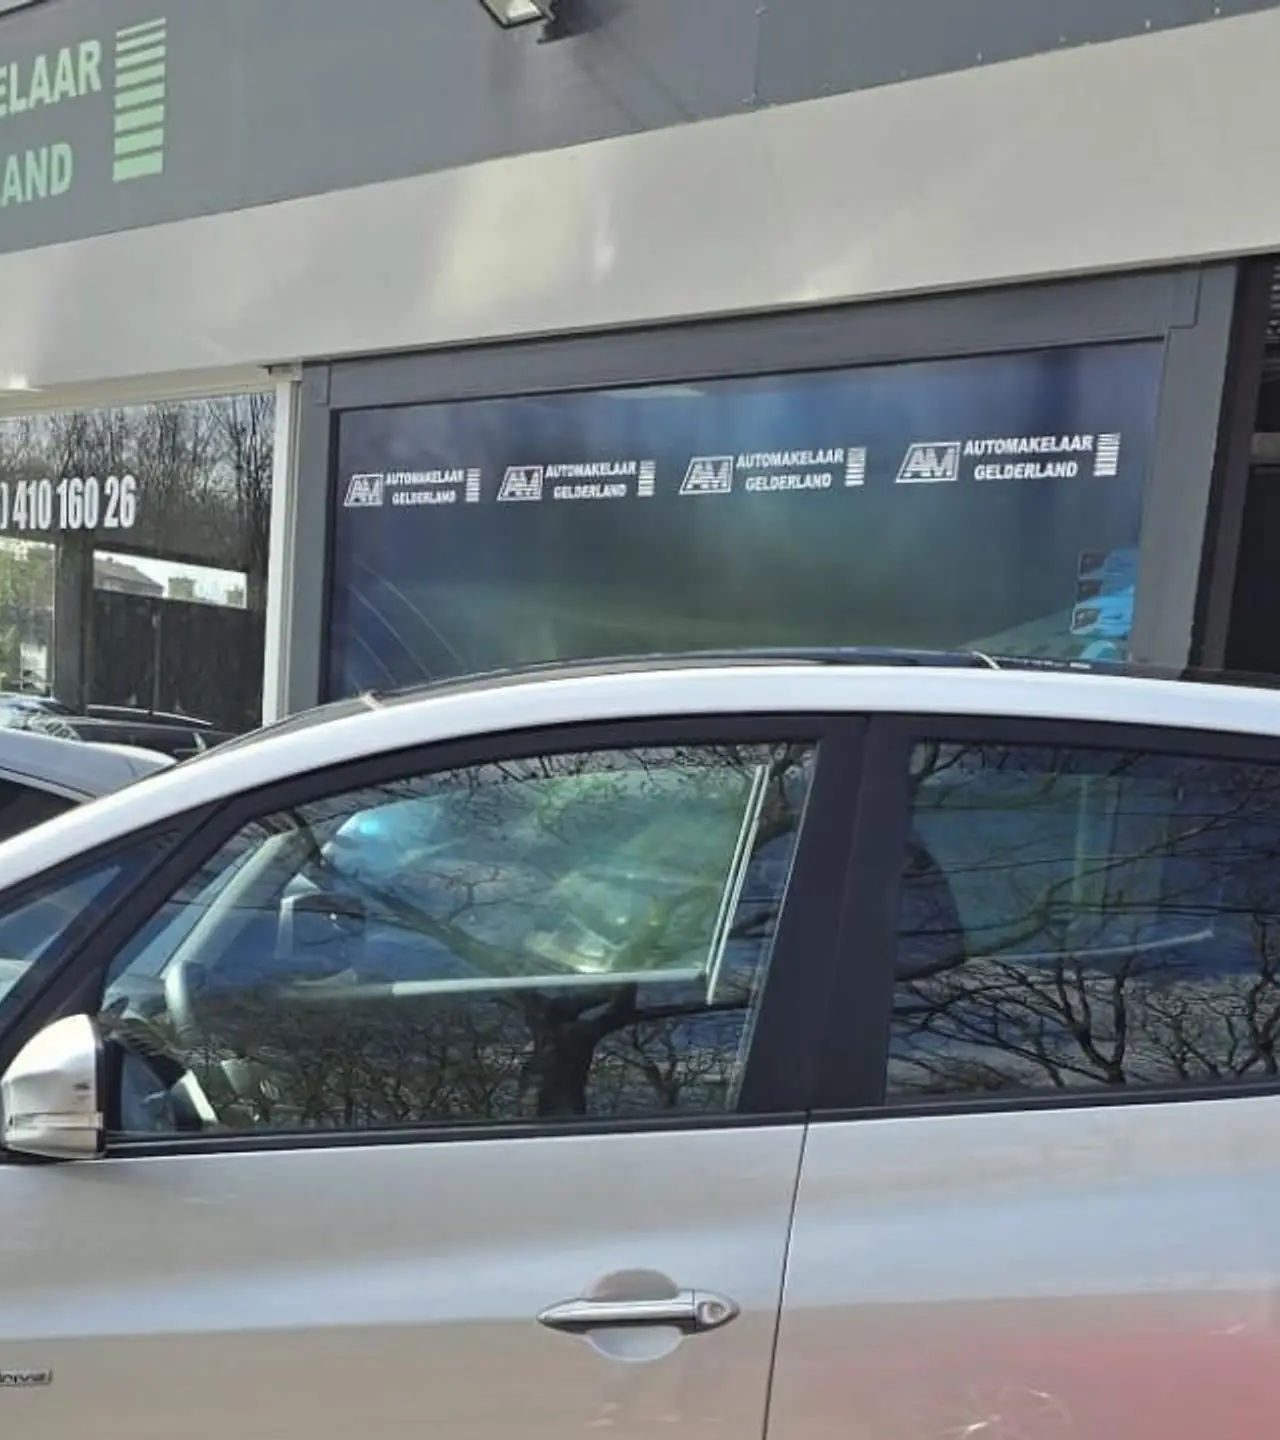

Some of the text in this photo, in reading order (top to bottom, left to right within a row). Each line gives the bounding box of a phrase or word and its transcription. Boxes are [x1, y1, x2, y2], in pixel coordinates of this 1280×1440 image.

[963, 434, 1094, 457] AUTOMAKELAAR
[736, 448, 844, 469] AUTOMAKELAAR
[545, 461, 638, 479] AUTOMAKELAAR
[974, 461, 1078, 480] GELDERLAND
[553, 484, 628, 500] GELDERLAND
[745, 473, 832, 492] GELDERLAND
[12, 478, 52, 529] 410
[56, 475, 100, 529] 160
[103, 474, 137, 528] 26
